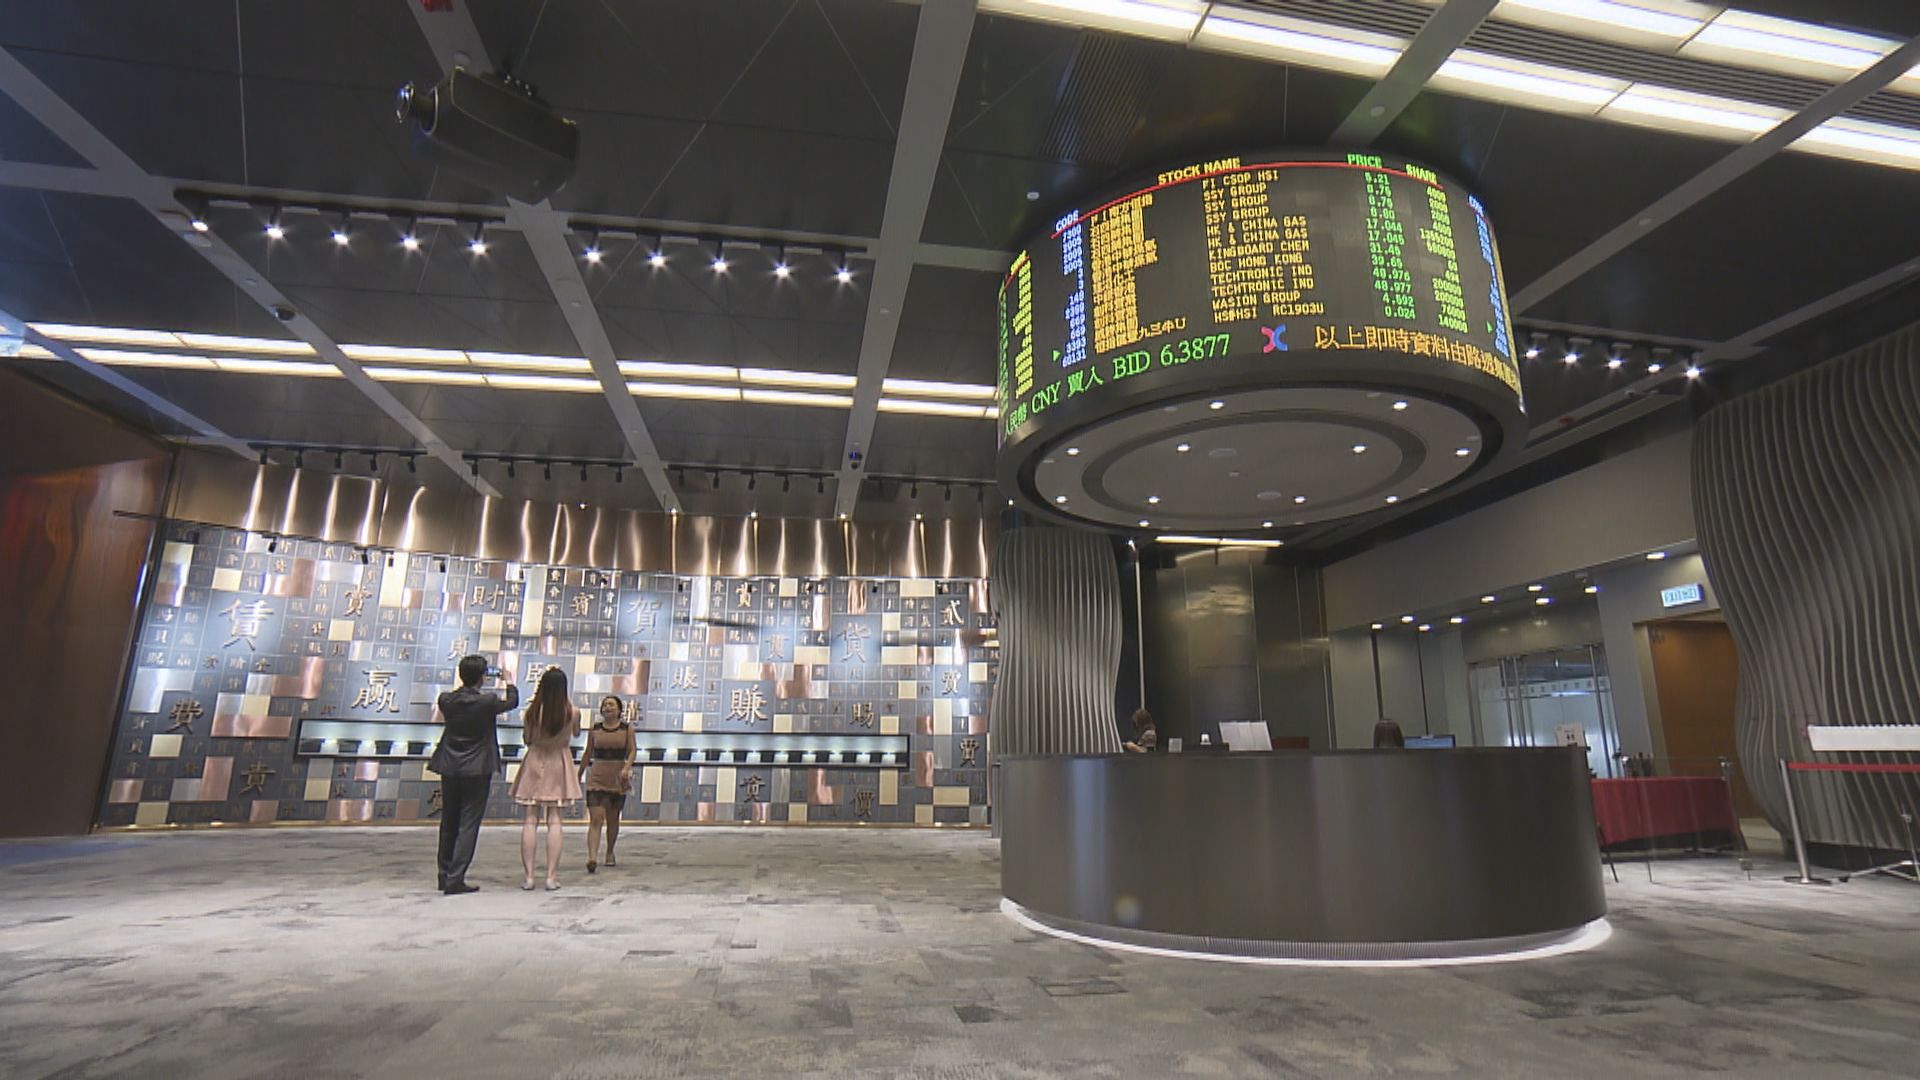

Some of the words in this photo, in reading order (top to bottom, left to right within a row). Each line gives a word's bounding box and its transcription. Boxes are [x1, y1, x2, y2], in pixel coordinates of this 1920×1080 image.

[1158, 164, 1200, 185] STOCK
[1203, 157, 1240, 175] NAME
[1347, 154, 1382, 168] PRICE
[1258, 170, 1279, 181] HSI
[1203, 188, 1225, 201] SSY
[1230, 182, 1267, 197] GROUP
[1205, 200, 1225, 213] SSY
[1231, 194, 1268, 208] GROUP
[1056, 210, 1079, 233] CODE
[1206, 212, 1226, 225] SSY
[1232, 206, 1269, 220] GROUP
[1228, 221, 1236, 234] &
[1241, 218, 1278, 231] CHINA
[1283, 215, 1307, 227] GAS
[1229, 234, 1237, 245] &
[1243, 230, 1279, 243] CHINA
[1284, 228, 1308, 240] GAS
[1281, 240, 1310, 252] CHEM
[1210, 260, 1232, 273] BOC
[1274, 253, 1303, 265] KONG
[1211, 266, 1284, 285] TECHTRONIC
[1292, 265, 1312, 277] IND
[1212, 279, 1284, 298] TECHTRONIC
[1293, 278, 1314, 290] IND
[1213, 293, 1258, 311] WASION
[1263, 290, 1301, 304] GROUP
[1272, 303, 1324, 317] RC1903U
[1031, 381, 1061, 413] CNY
[1112, 350, 1151, 380] BID
[1160, 333, 1230, 366] 6.3877
[470, 584, 505, 611] 財
[351, 664, 400, 713] 贏
[726, 683, 768, 727] 賺
